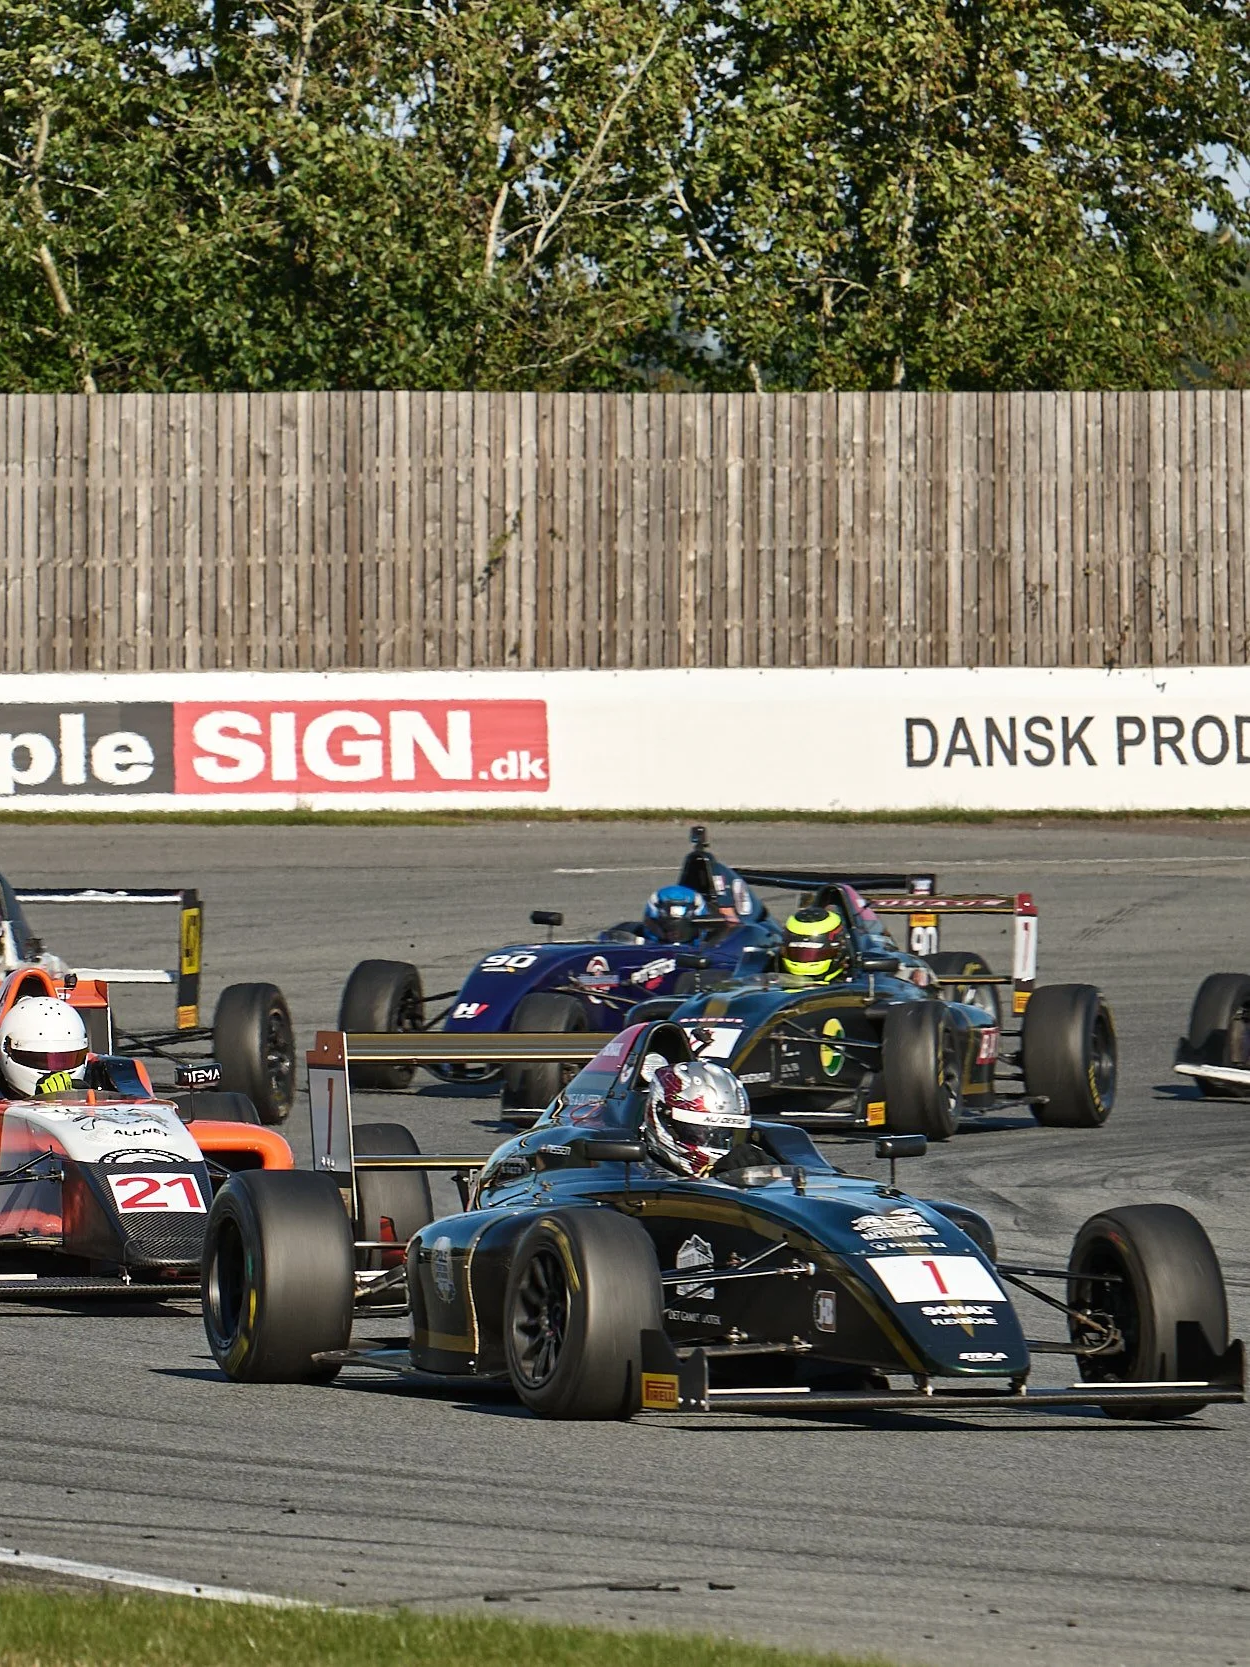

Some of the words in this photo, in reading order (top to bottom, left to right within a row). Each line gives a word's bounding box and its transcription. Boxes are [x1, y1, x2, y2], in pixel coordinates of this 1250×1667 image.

[905, 716, 1098, 768] DANSK
[481, 954, 538, 969] 90
[115, 1177, 201, 1209] 21
[921, 1261, 949, 1294] 1
[921, 1305, 994, 1316] SONAX
